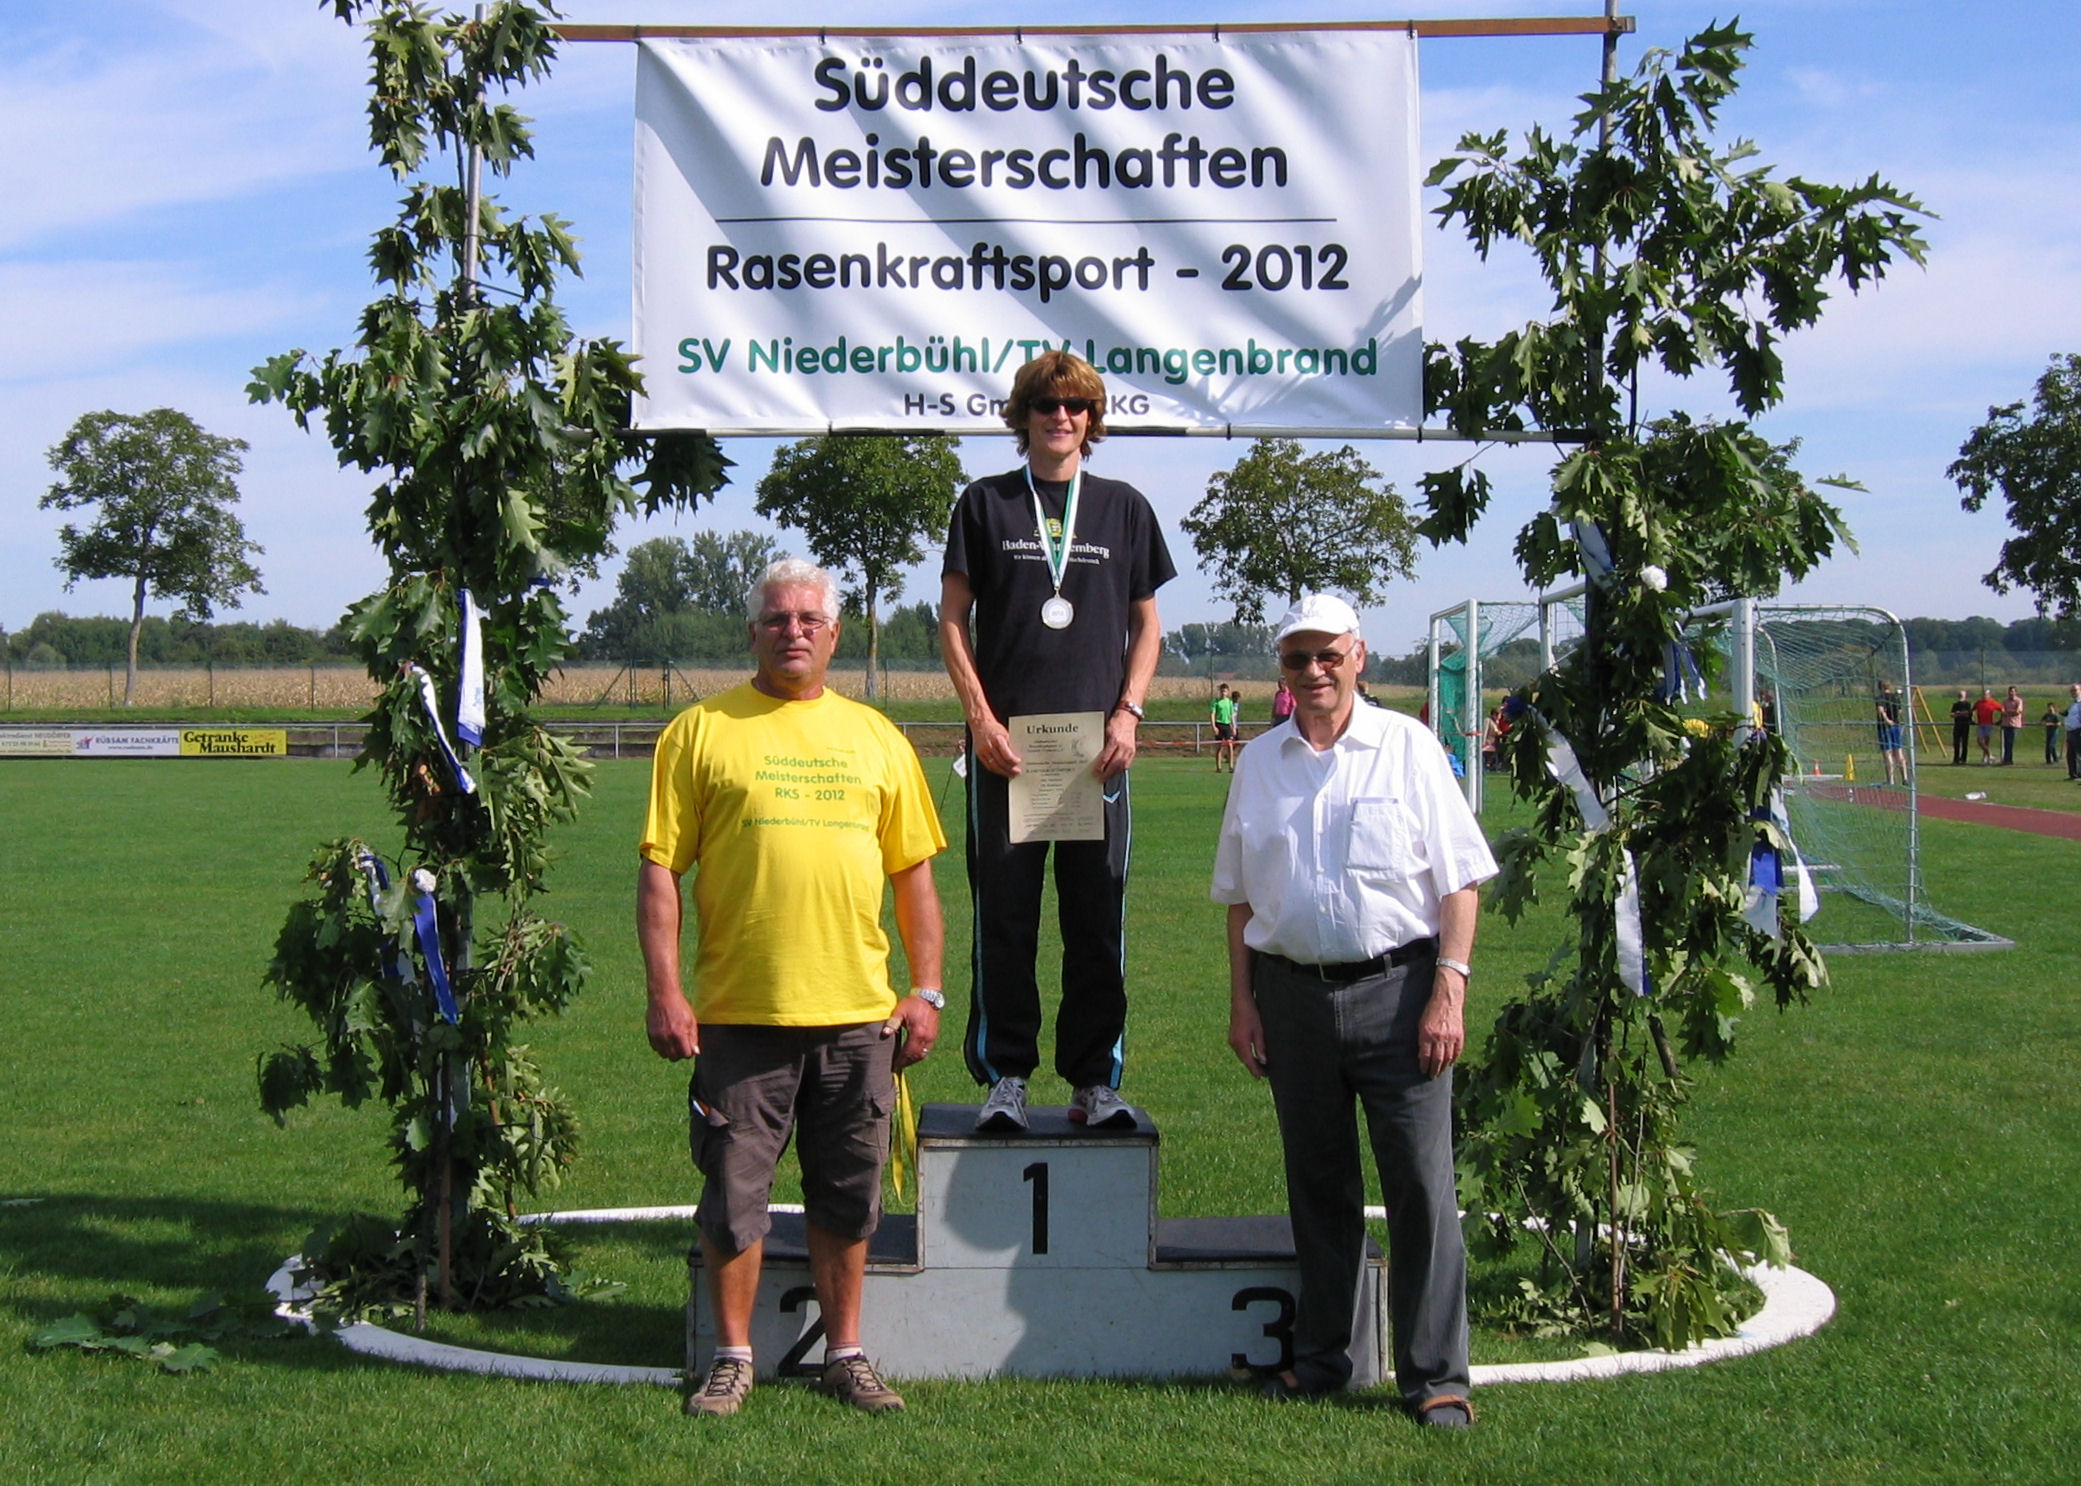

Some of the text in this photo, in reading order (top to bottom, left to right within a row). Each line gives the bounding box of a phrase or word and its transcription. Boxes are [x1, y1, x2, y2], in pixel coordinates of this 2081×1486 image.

[814, 53, 1235, 112] Süddeutsche
[760, 132, 1288, 190] Meisterschaften
[706, 241, 1349, 303] Rasenkraftsport - 2012
[677, 338, 730, 374] SV
[1086, 338, 1378, 384] Langenbrand
[904, 393, 956, 416] H-S
[200, 742, 276, 753] Maushardt
[1027, 723, 1079, 734] Urkunde
[755, 770, 862, 784] Meisterschaften
[764, 755, 848, 768] Süddeutsche
[775, 787, 800, 799] RKS
[815, 789, 845, 801] 2012
[1022, 1161, 1049, 1256] 1
[777, 1286, 827, 1378] 2
[1231, 1286, 1296, 1376] 3
